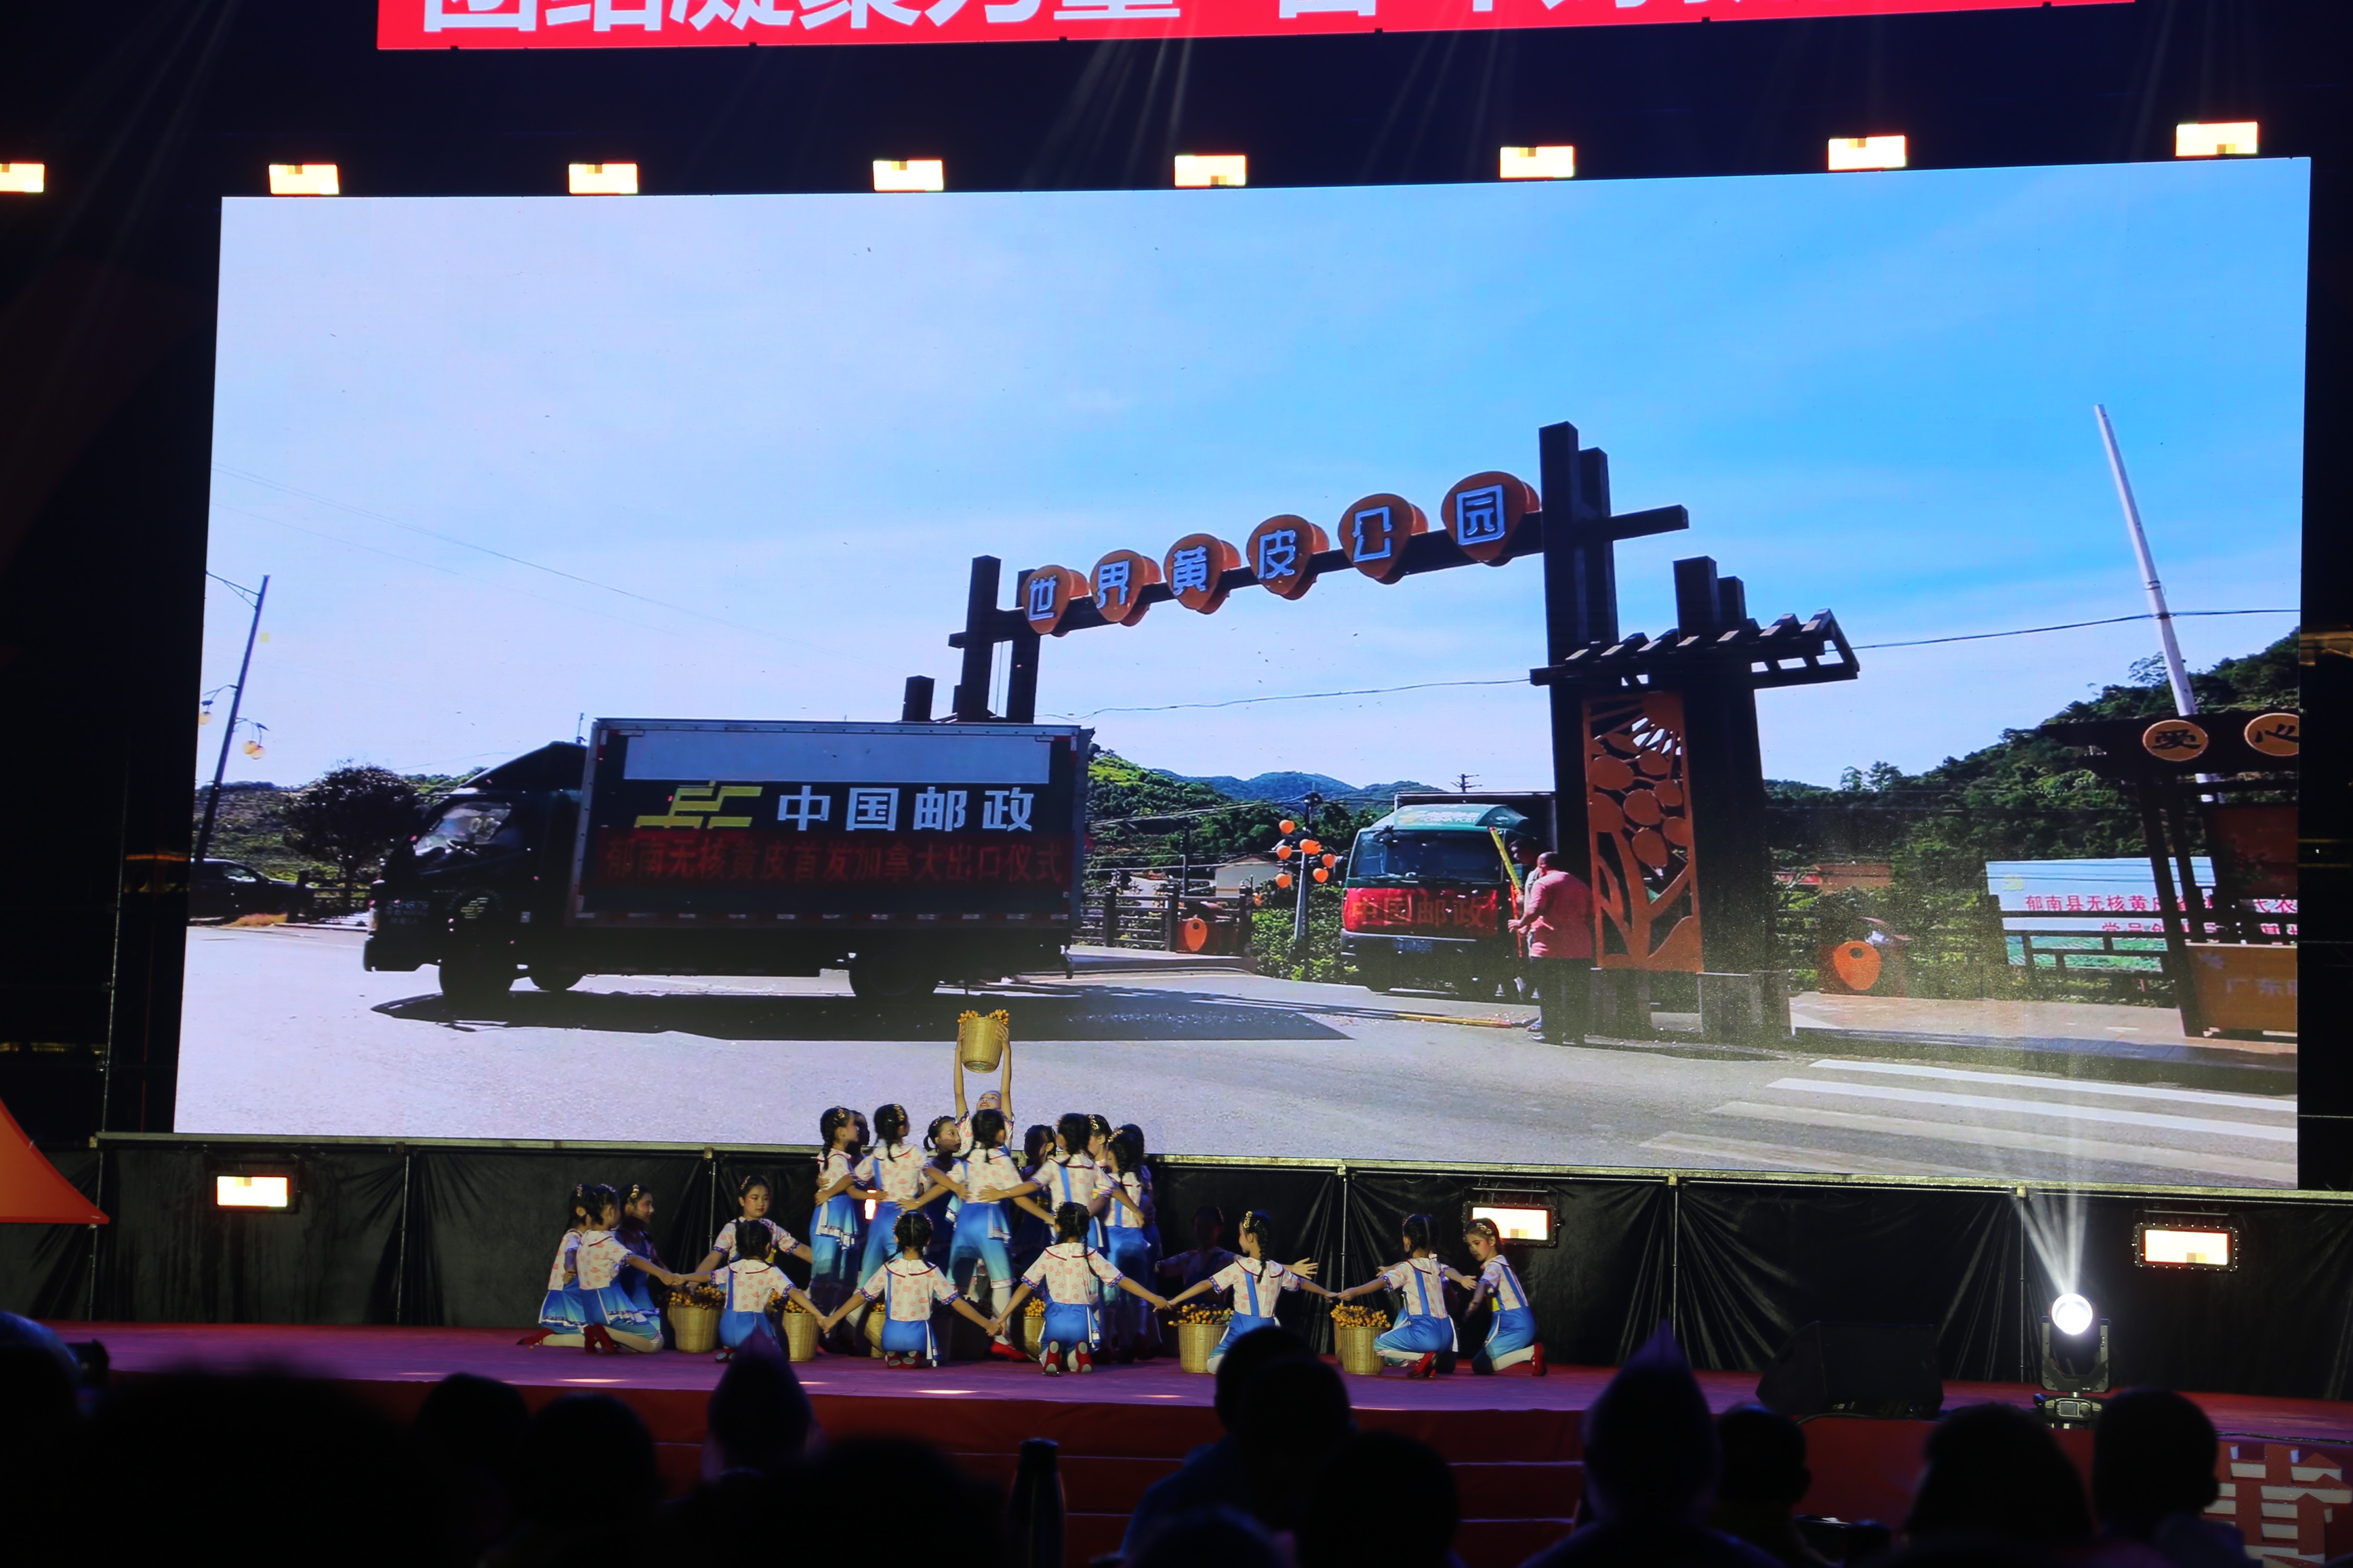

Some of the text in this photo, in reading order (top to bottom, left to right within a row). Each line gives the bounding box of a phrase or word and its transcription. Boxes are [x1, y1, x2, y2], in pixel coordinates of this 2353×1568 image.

[1027, 484, 1507, 622] 世界黄皮公园
[776, 785, 1035, 832] 中国邮政
[1353, 897, 1484, 928] 中国邮政
